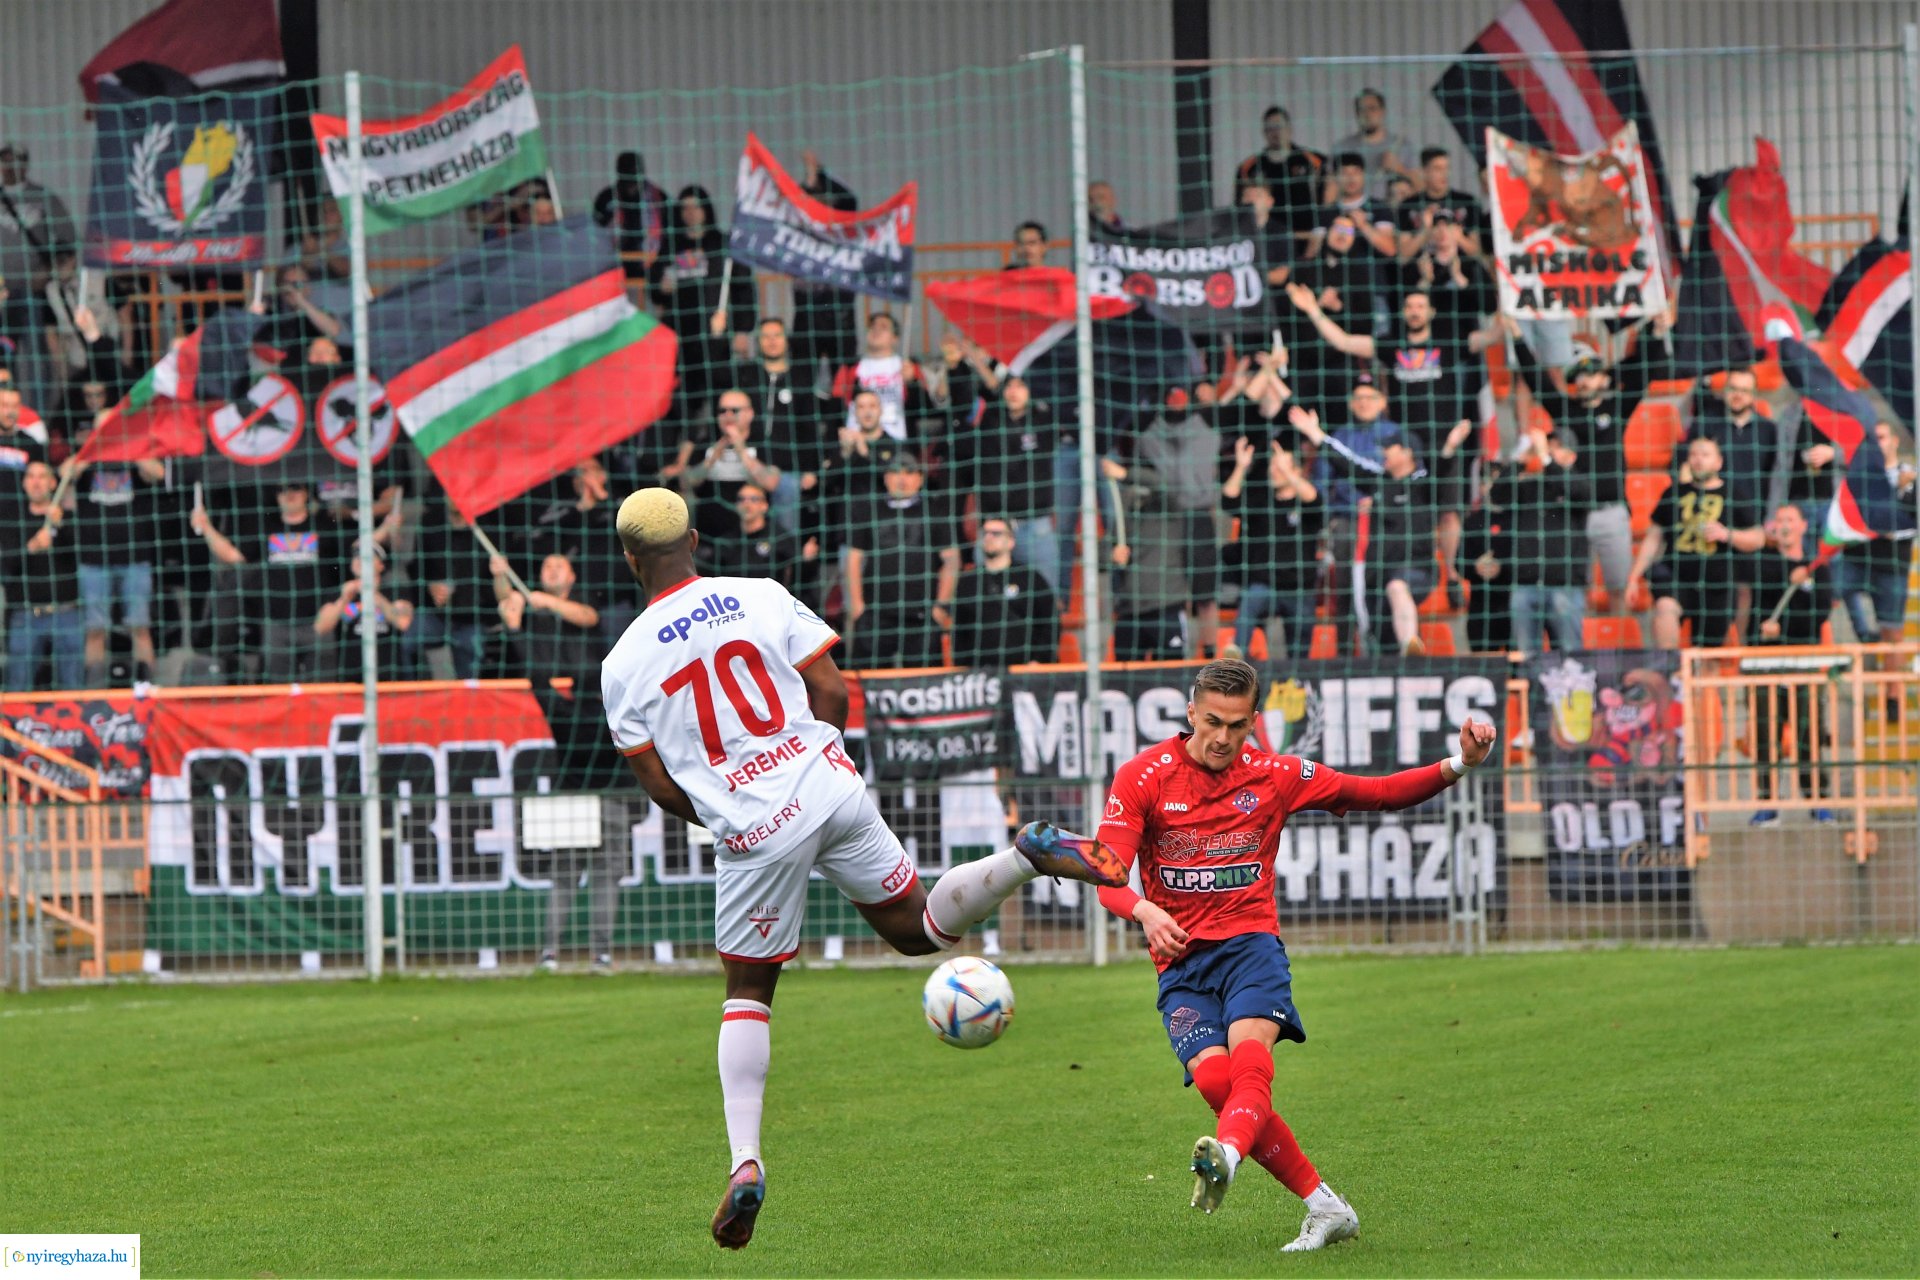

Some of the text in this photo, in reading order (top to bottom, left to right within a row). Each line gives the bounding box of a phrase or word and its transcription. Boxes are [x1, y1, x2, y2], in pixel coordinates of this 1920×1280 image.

[327, 69, 525, 161] MGYARORSZÁG
[1509, 250, 1648, 275] MISKOLC
[1516, 283, 1643, 309] AFRIKA
[657, 592, 741, 644] apollo
[706, 610, 747, 630] TYRES
[659, 639, 786, 767] 70
[724, 735, 808, 793] JEREMIE
[746, 798, 803, 847] BELFRY
[1163, 802, 1188, 812] JAKO
[1552, 796, 1686, 852] OLD F
[1229, 1107, 1259, 1121] JAKO
